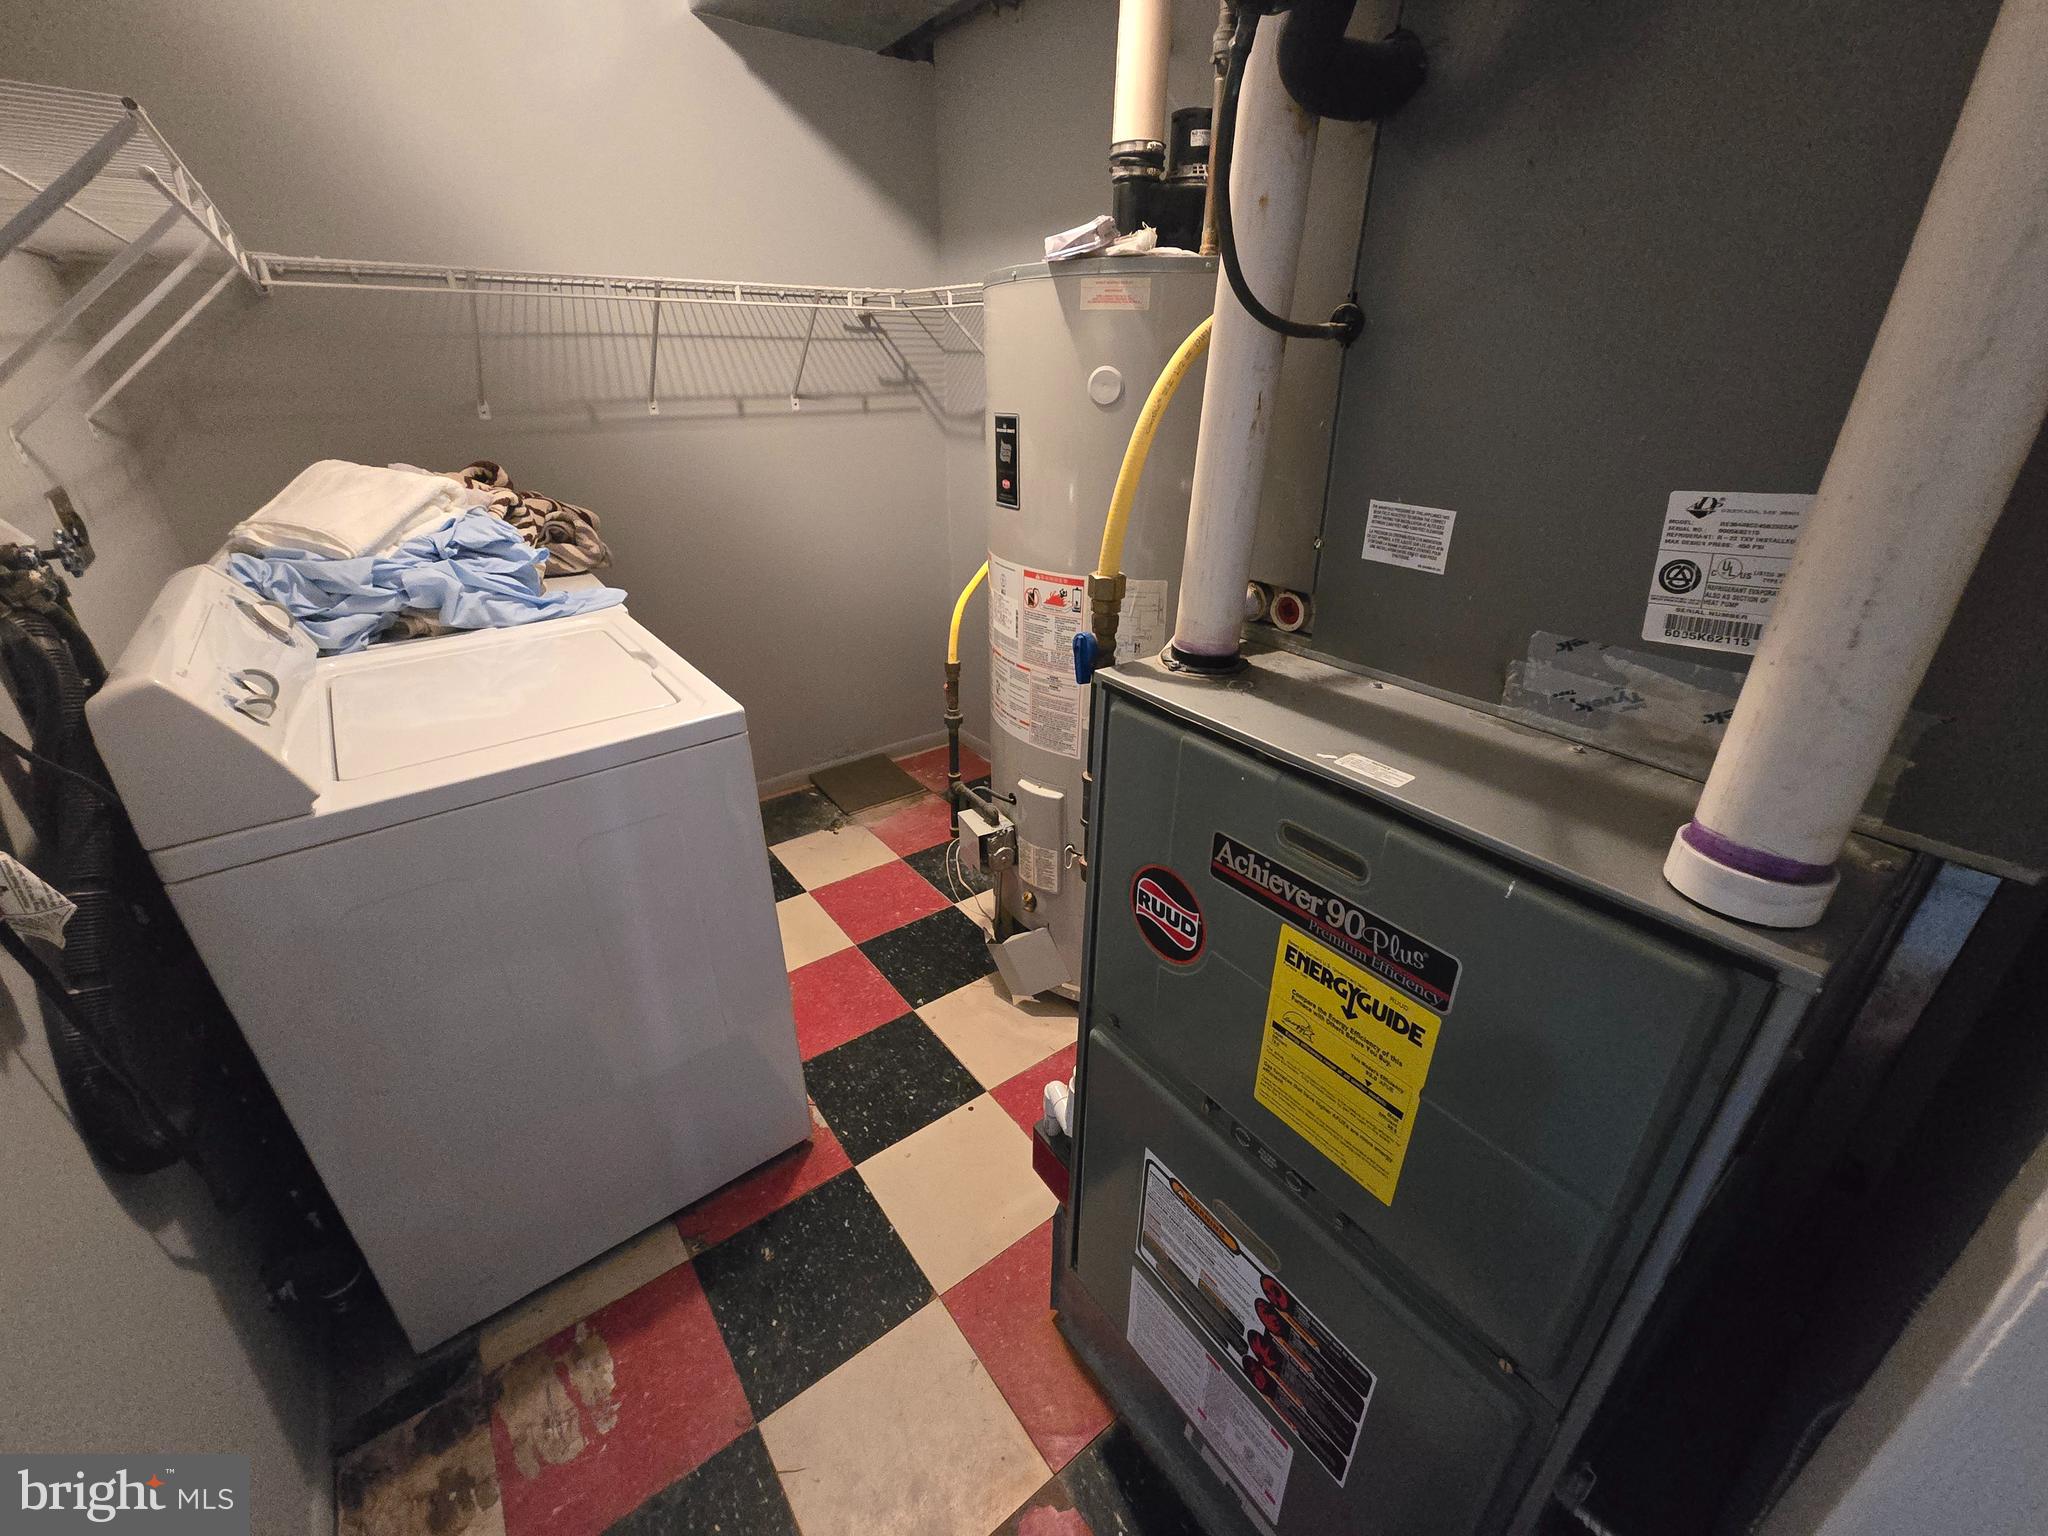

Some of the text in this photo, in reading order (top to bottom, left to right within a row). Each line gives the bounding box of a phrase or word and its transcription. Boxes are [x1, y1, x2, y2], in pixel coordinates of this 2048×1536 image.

[1675, 607, 1748, 620] SERIAL NUMBER
[1136, 889, 1197, 938] RUUD
[1214, 841, 1425, 970] Achiever 90 Plus
[1285, 944, 1426, 1048] ENERGYGUIDE
[1309, 919, 1444, 1007] Premium Efficiency
[1291, 988, 1316, 1010] Compare
[1316, 1005, 1326, 1017] the
[1327, 1012, 1348, 1032] Energy
[1349, 1027, 1380, 1053] Efficiency
[1390, 1054, 1403, 1068] this
[1325, 1018, 1344, 1036] Others
[1345, 1031, 1365, 1049] Before
[1365, 1045, 1377, 1058] You
